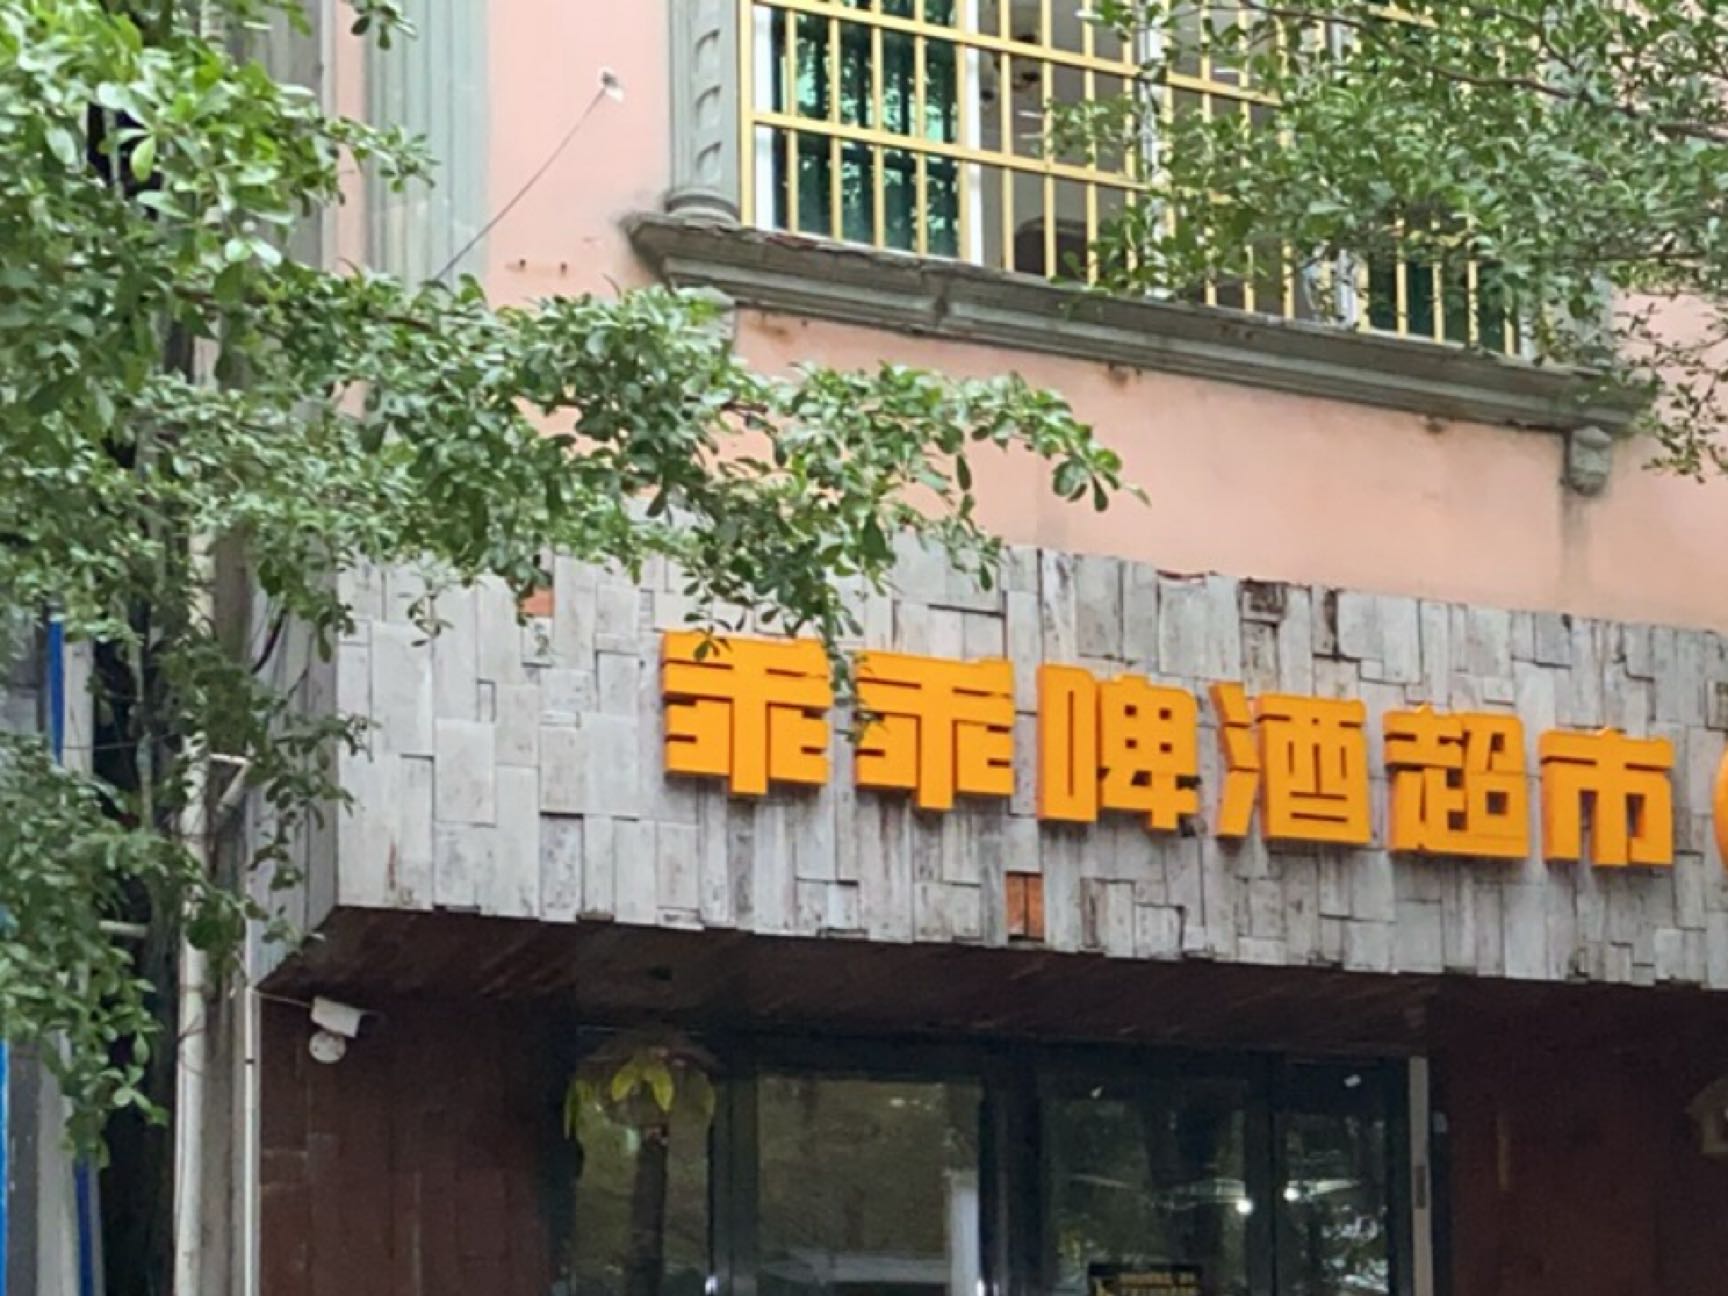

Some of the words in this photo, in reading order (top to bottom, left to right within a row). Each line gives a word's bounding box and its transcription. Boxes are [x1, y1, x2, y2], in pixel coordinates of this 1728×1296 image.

[662, 629, 1674, 868] 乖乖啤酒超市
